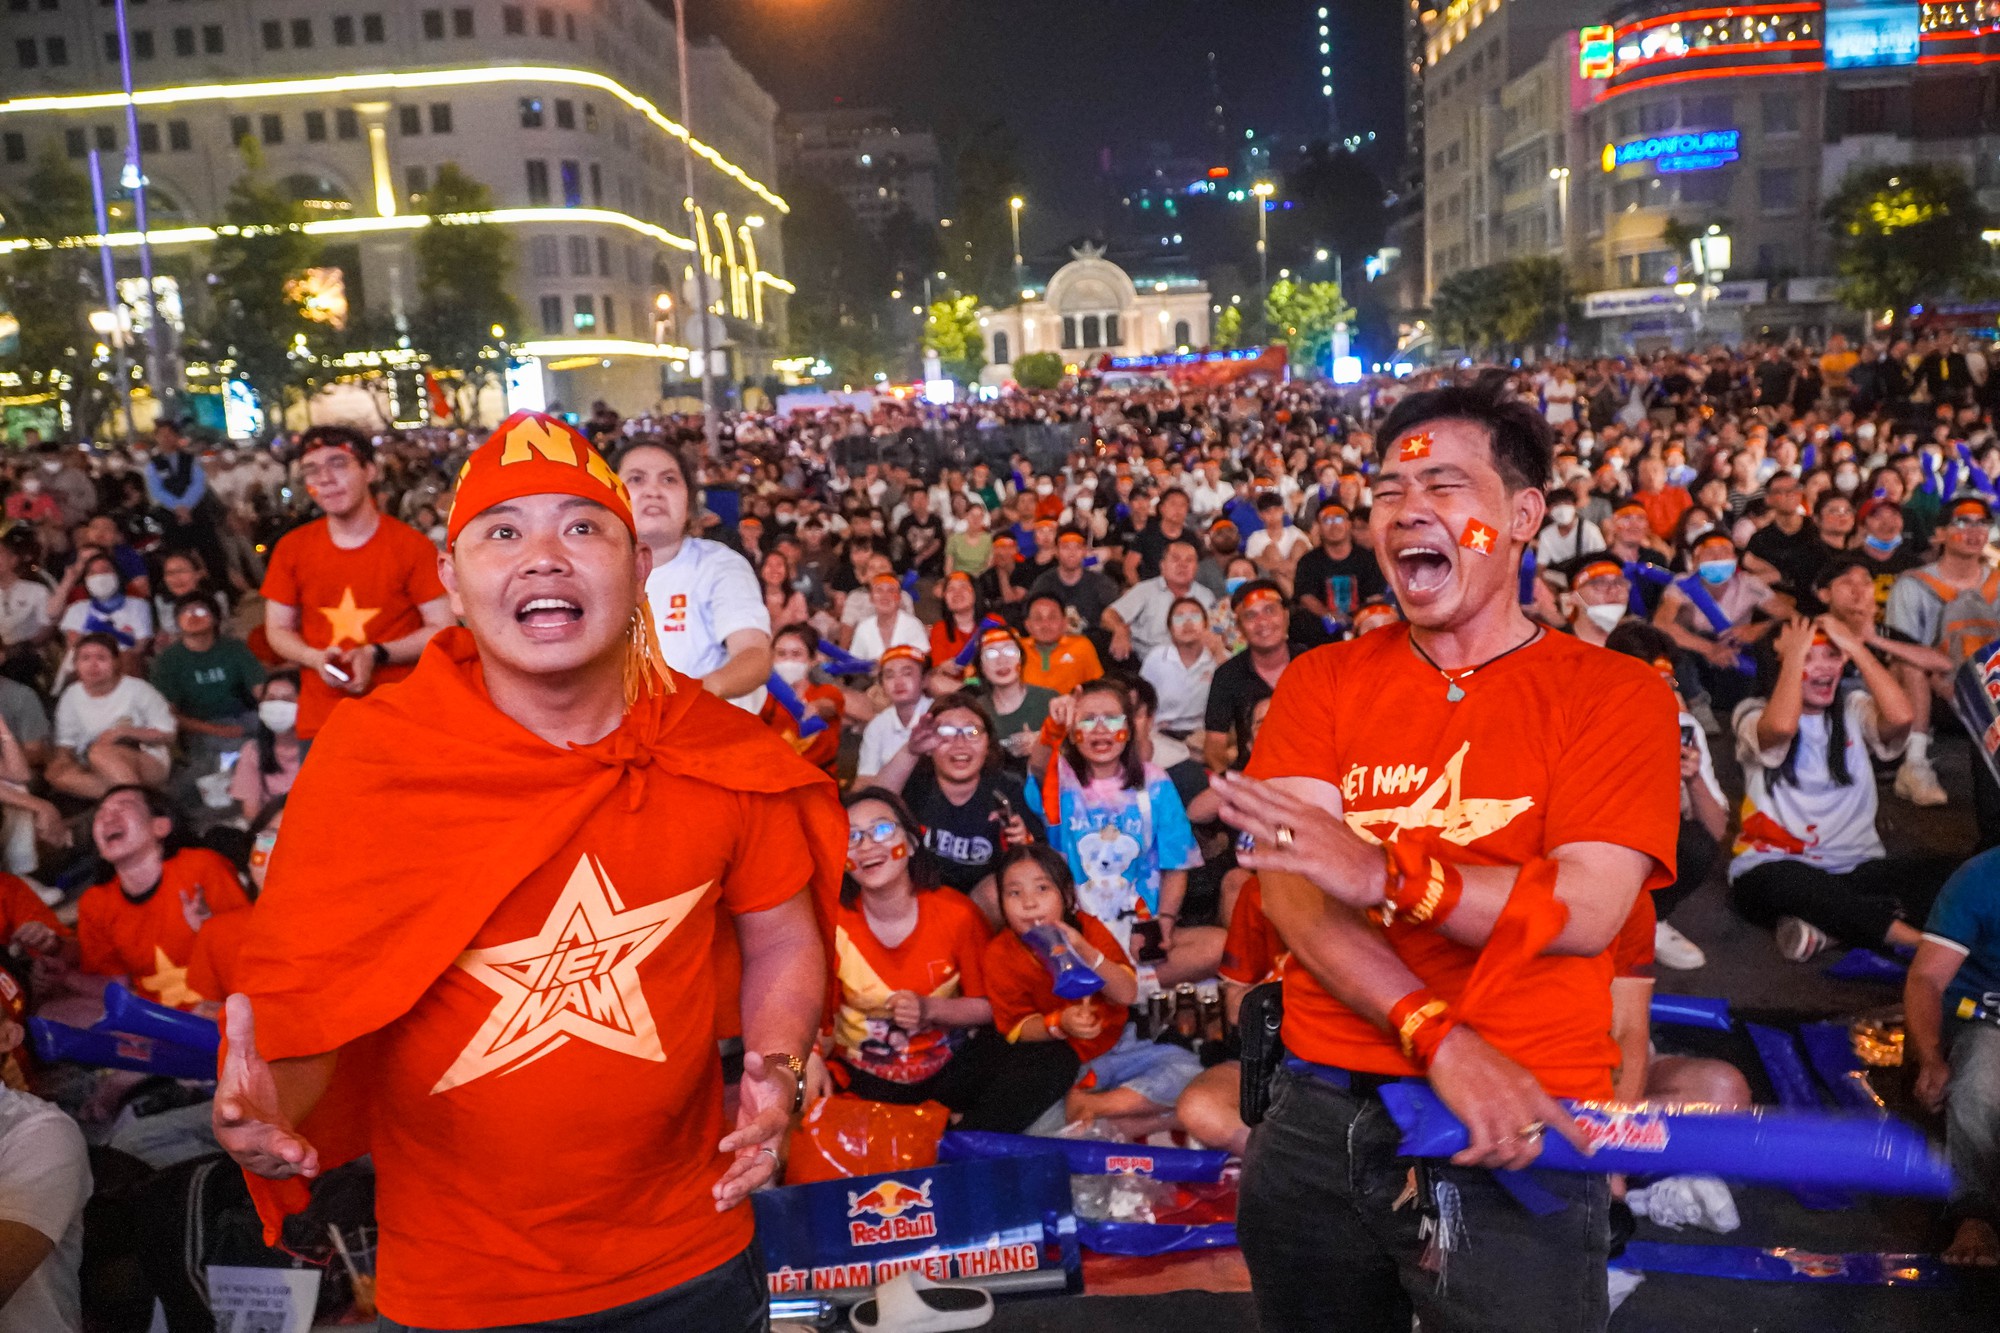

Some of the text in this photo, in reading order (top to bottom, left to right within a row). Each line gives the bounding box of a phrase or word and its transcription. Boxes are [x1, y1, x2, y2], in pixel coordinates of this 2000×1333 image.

[1372, 764, 1428, 797] NAM
[483, 971, 637, 1056] NAM
[850, 1213, 936, 1245] Red Bull
[812, 1262, 871, 1291] NAM
